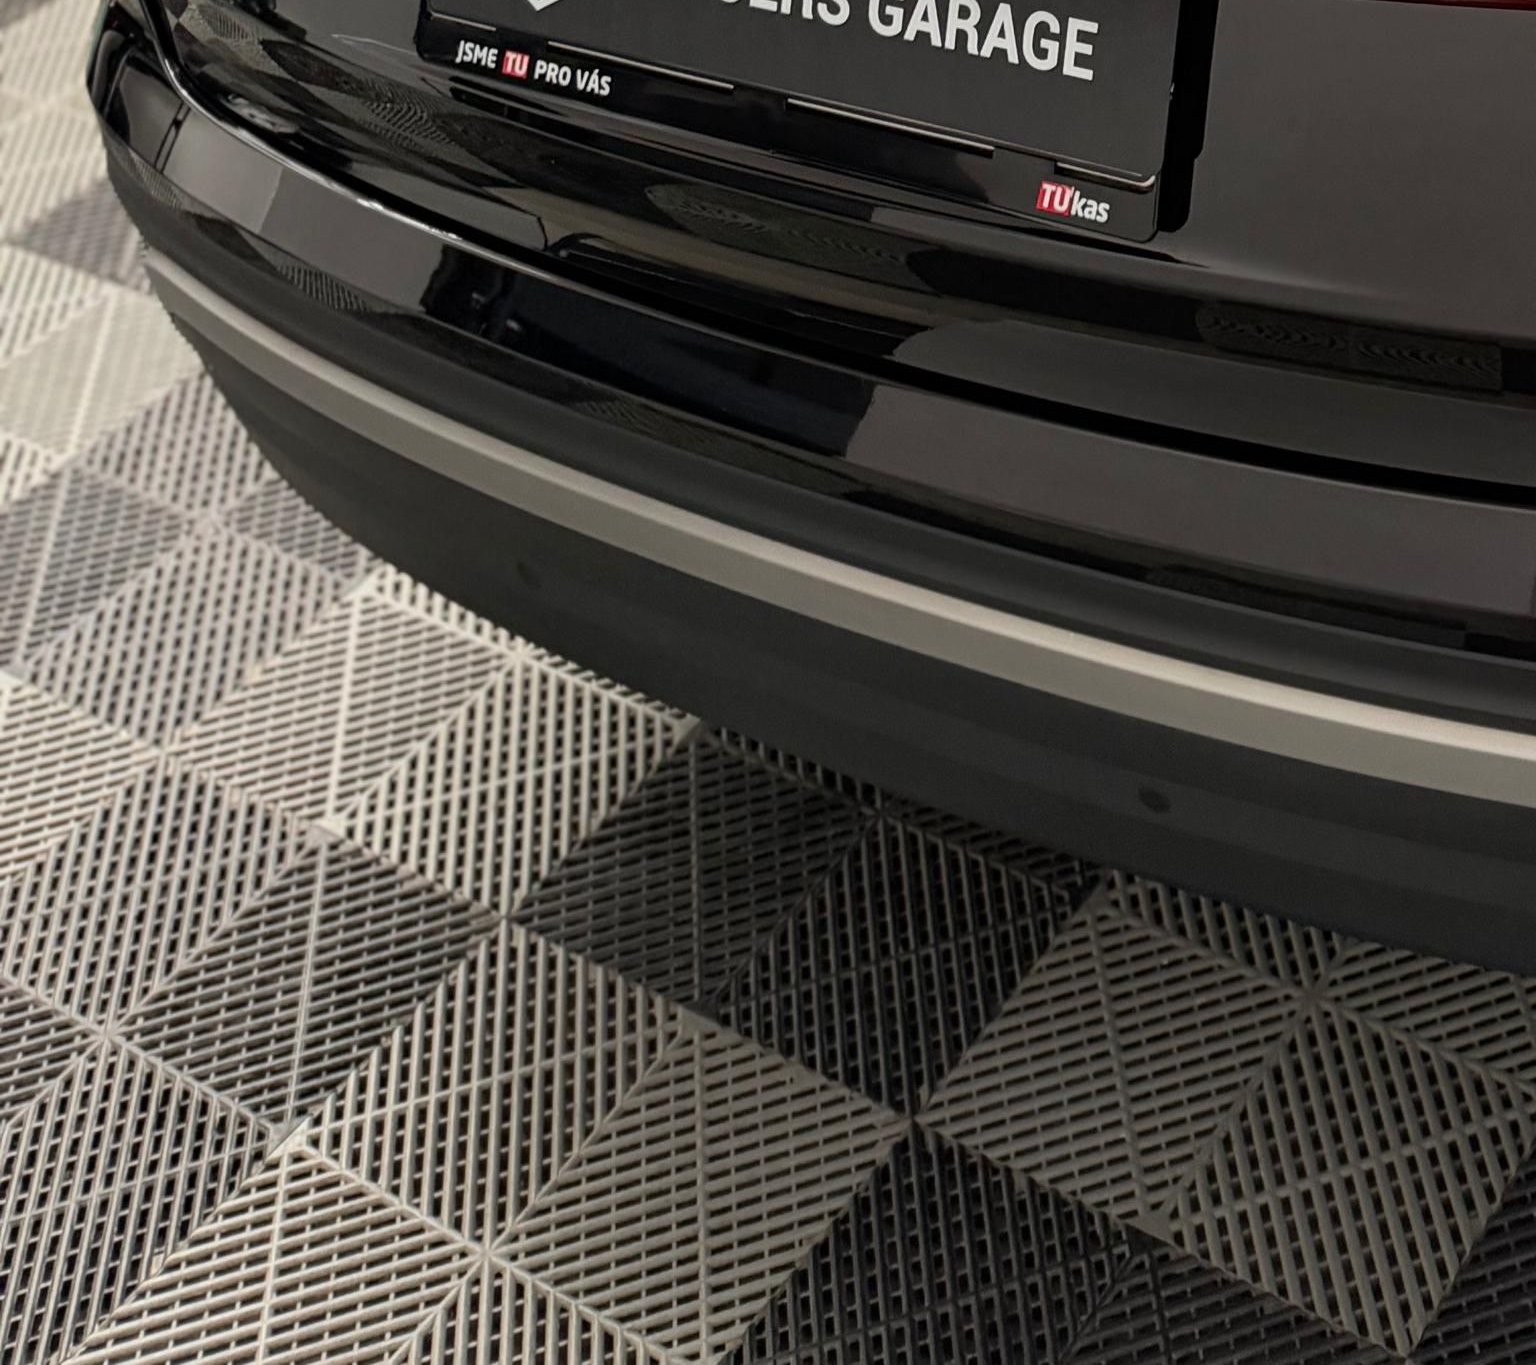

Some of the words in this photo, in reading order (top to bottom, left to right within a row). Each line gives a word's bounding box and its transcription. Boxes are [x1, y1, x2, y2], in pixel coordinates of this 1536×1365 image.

[455, 39, 498, 69] JSME
[503, 51, 529, 78] TU
[534, 59, 572, 87] PRO
[576, 68, 612, 97] VÁS
